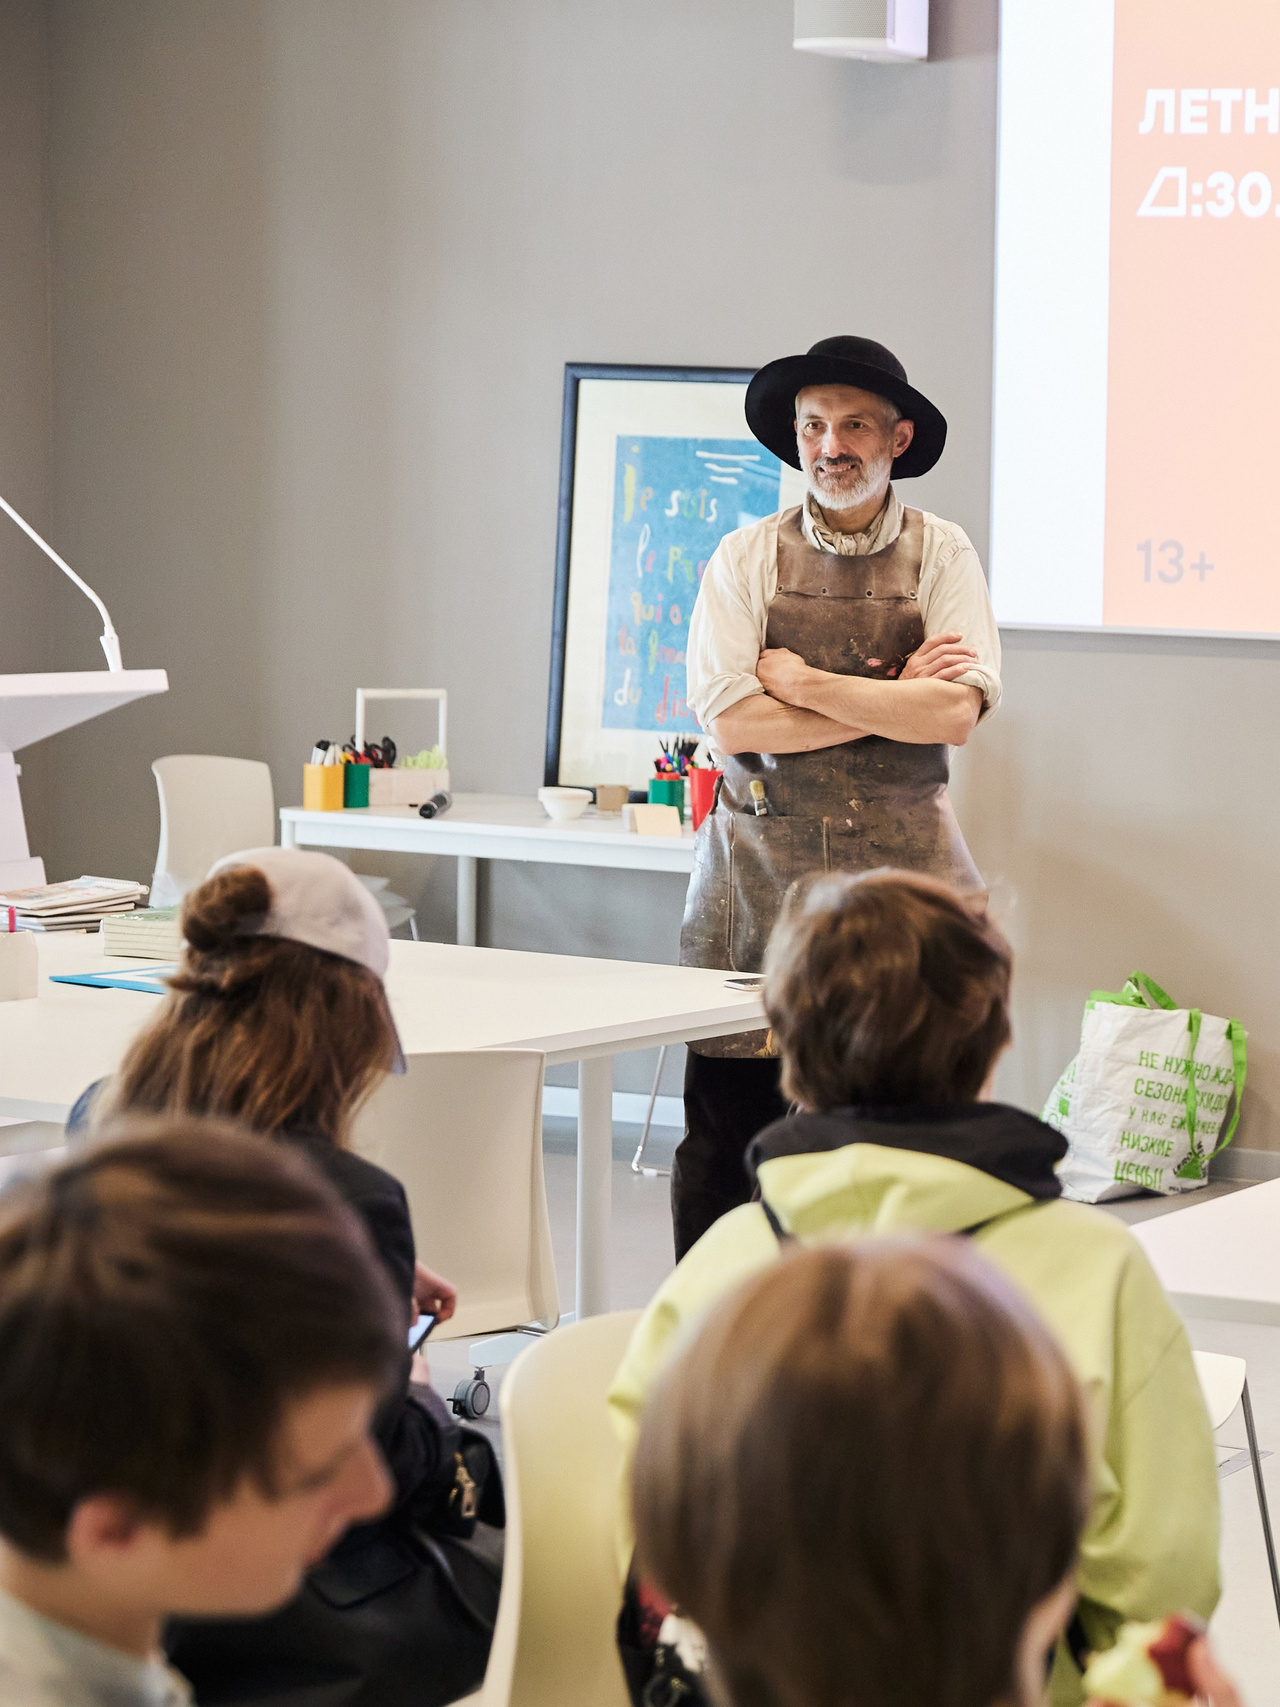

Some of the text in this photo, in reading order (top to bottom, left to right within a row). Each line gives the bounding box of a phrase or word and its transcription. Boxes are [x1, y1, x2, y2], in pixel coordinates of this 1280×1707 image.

[664, 488, 718, 524] suis
[1136, 538, 1215, 584] 13+
[1139, 1051, 1159, 1070] НЕ
[1141, 1109, 1166, 1126] НАС
[1120, 1131, 1174, 1158] НИЗКИЕ
